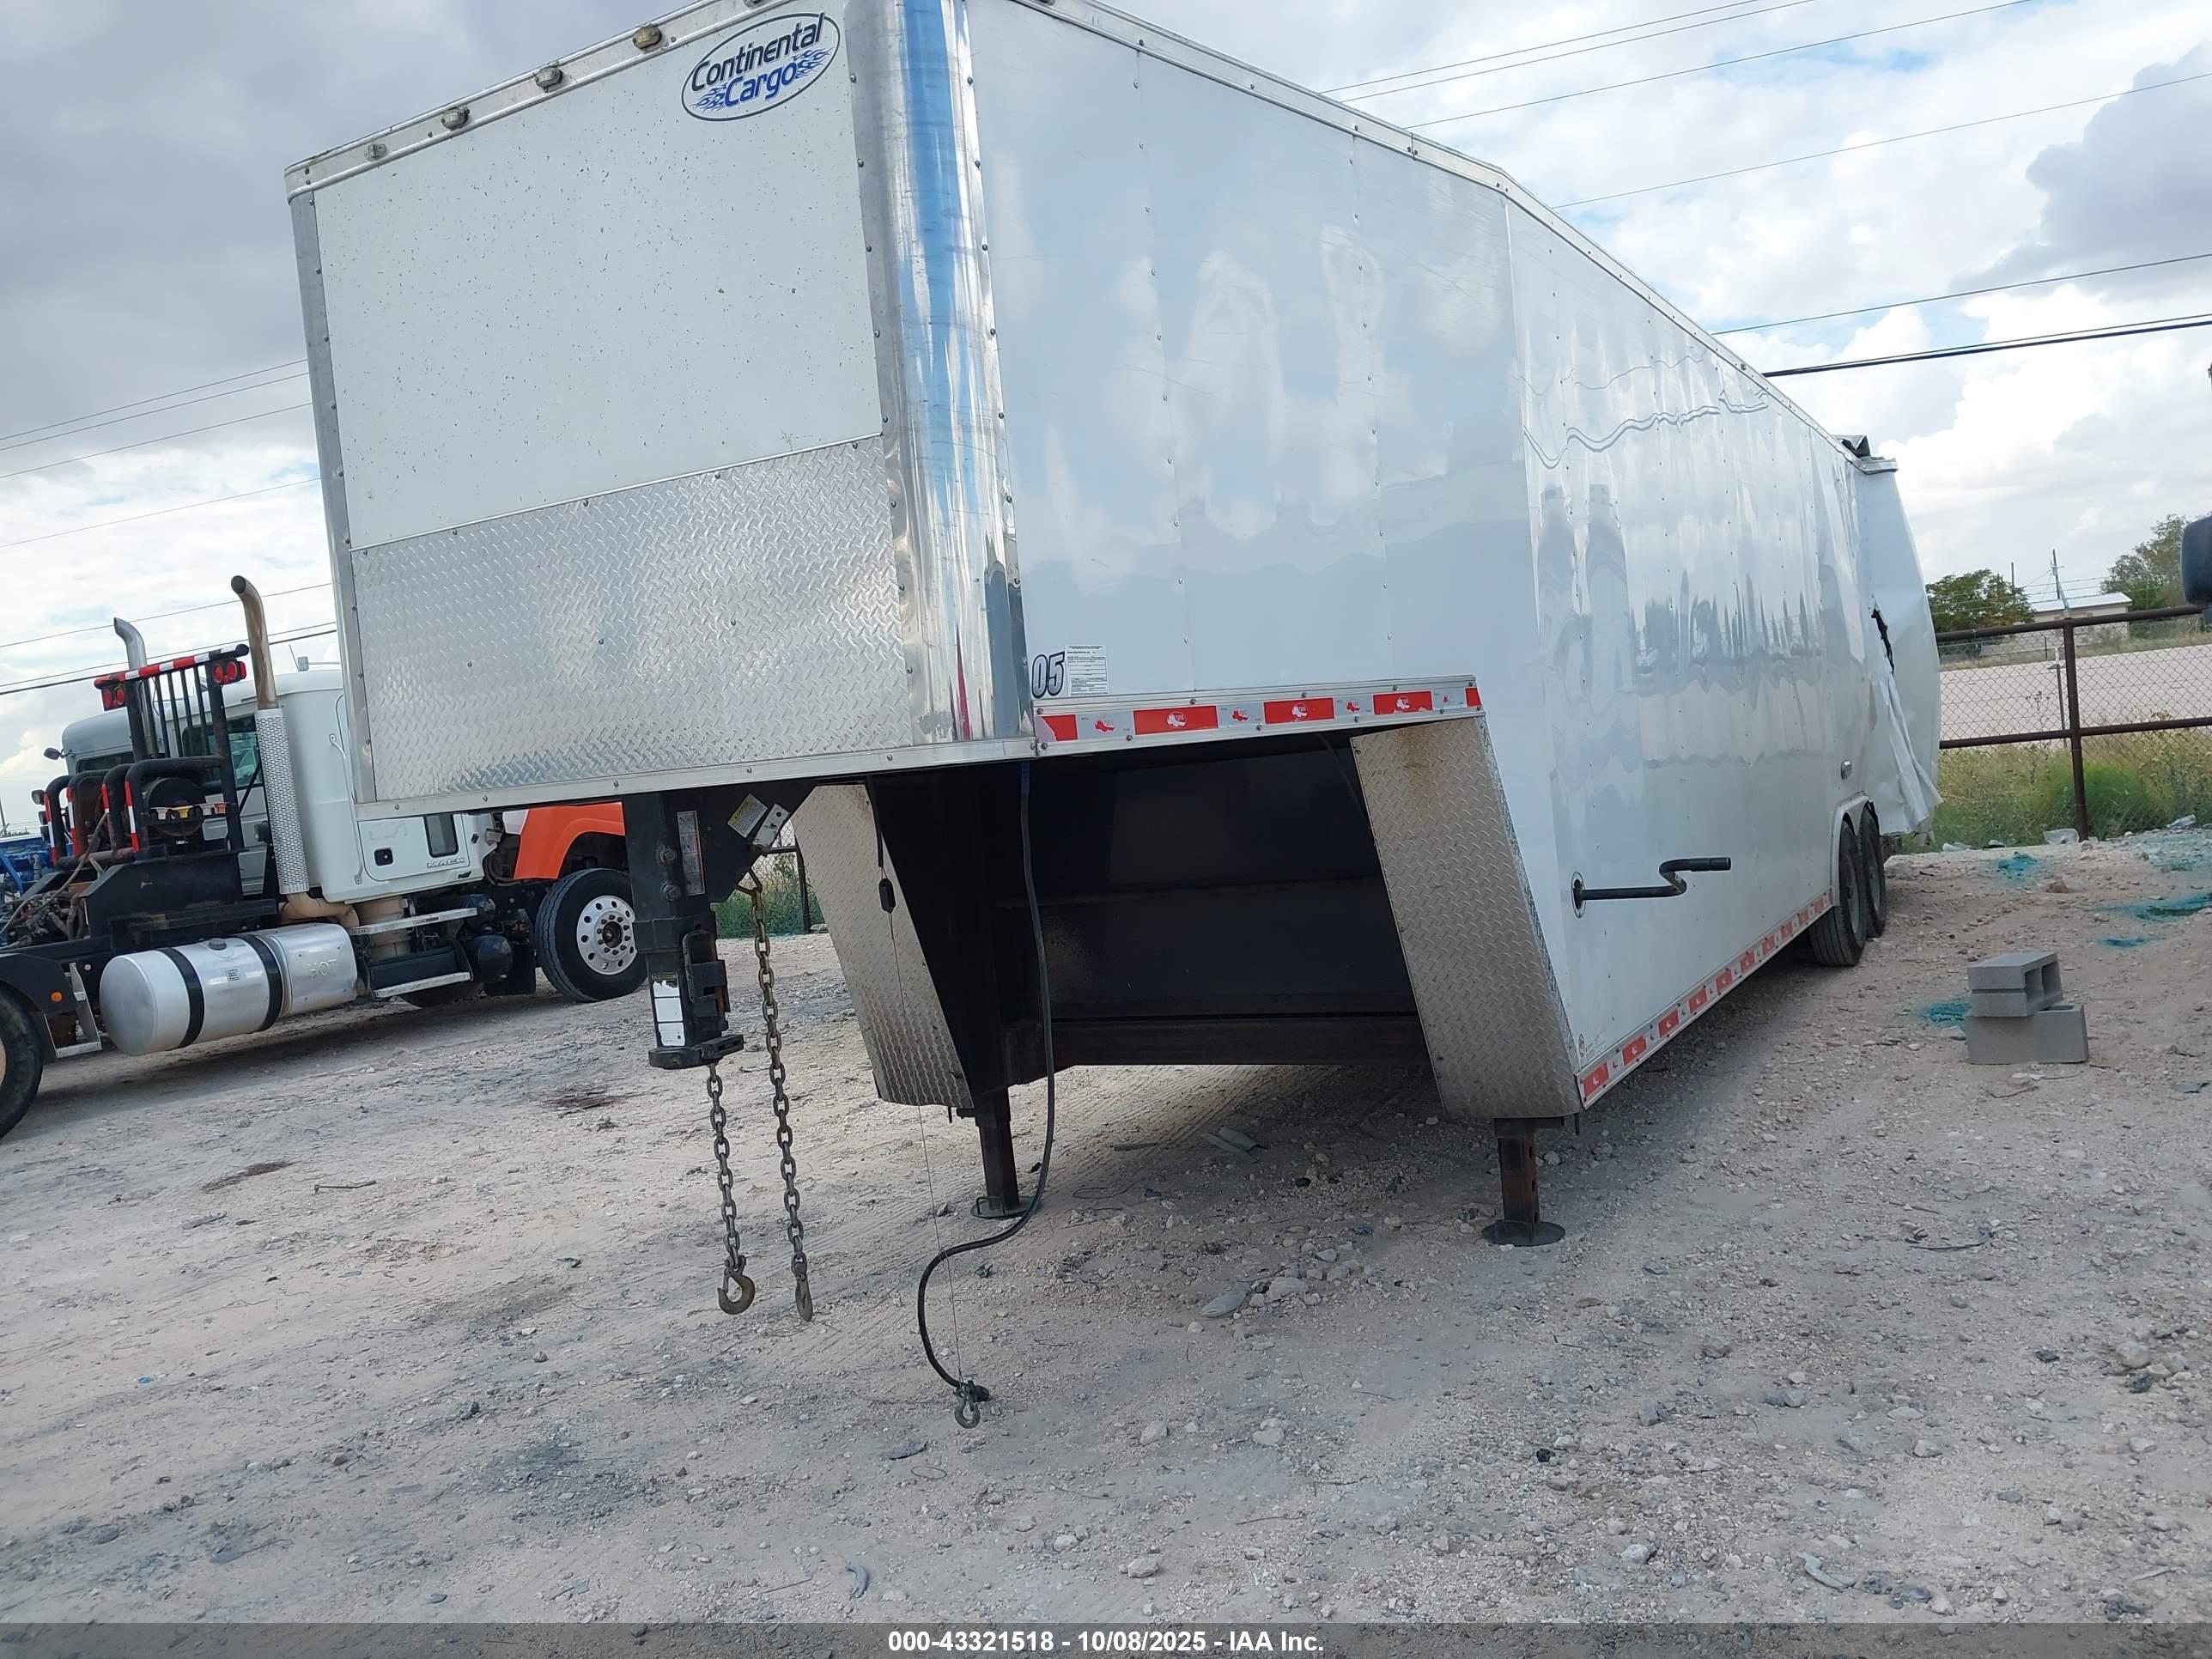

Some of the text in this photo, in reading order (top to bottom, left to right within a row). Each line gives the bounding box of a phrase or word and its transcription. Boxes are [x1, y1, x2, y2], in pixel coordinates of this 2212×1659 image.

[691, 12, 824, 91] Continental
[725, 62, 797, 106] Cargo
[1032, 651, 1065, 699] 05
[427, 857, 465, 869] MACK
